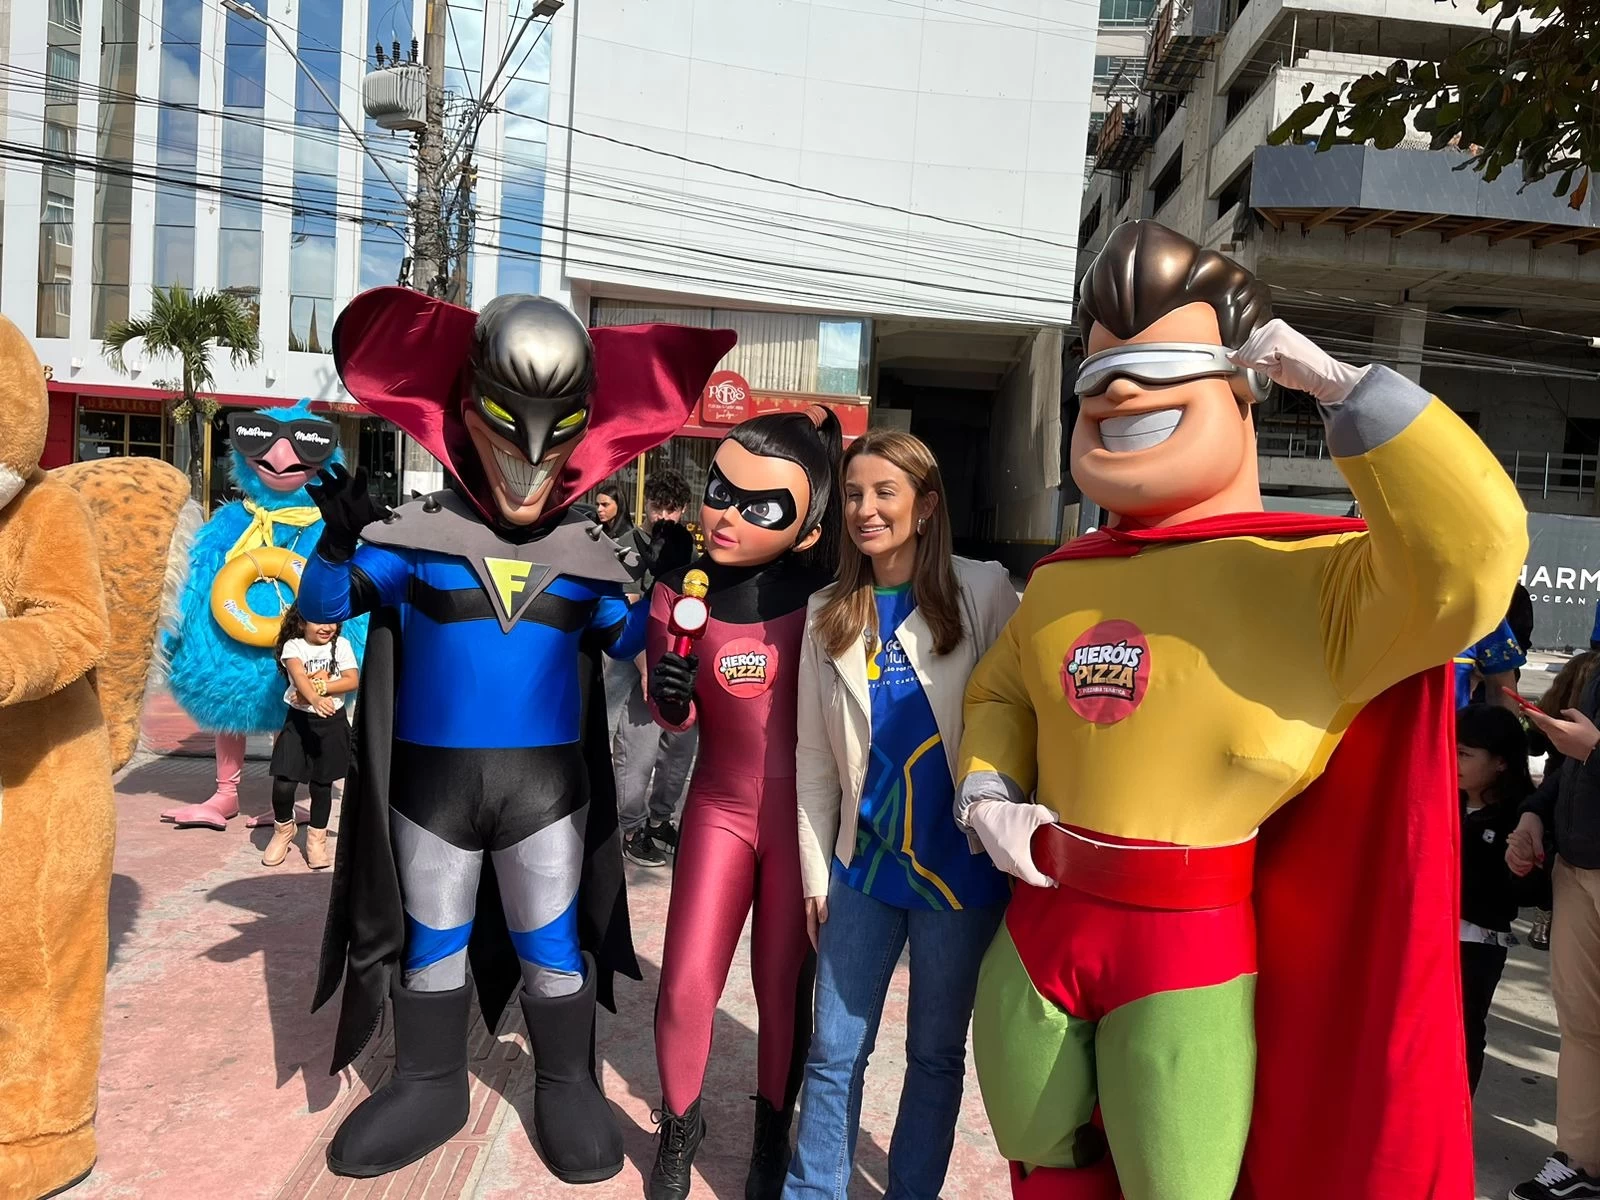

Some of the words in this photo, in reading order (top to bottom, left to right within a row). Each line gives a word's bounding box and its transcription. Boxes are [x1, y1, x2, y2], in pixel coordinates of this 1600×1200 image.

[484, 557, 533, 619] F
[1529, 593, 1586, 605] OCEAN
[720, 652, 767, 669] HERÓIS
[1074, 640, 1143, 668] HERÓIS
[725, 665, 765, 680] PIZZA
[1074, 664, 1134, 689] PIZZA
